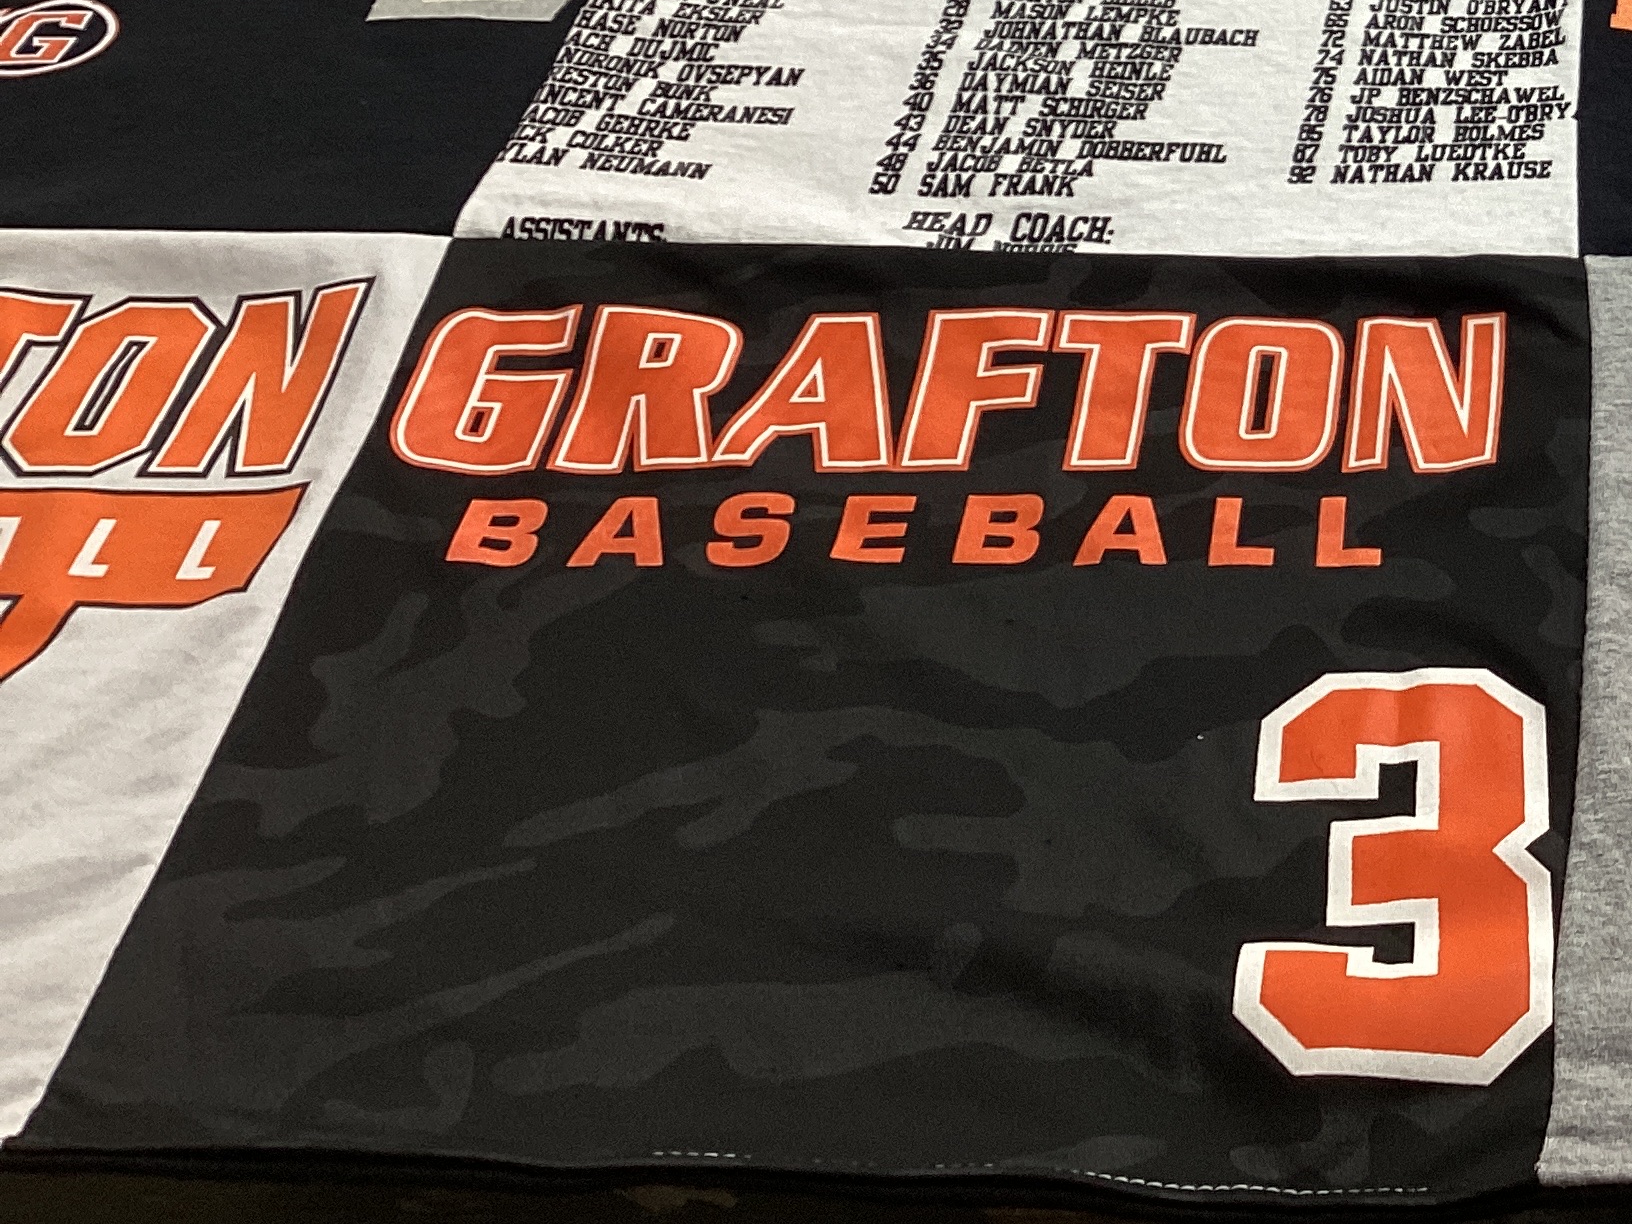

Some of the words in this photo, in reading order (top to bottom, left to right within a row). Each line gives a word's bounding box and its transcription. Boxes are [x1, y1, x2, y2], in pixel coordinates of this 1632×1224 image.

[1361, 30, 1482, 51] MATTHEW
[1498, 30, 1566, 51] ZABEL
[1312, 66, 1338, 86] 75
[1353, 67, 1425, 86] AIDAN
[1445, 69, 1509, 87] WEST
[637, 98, 795, 126] CAMERANESI
[902, 91, 934, 112] 40
[950, 92, 1026, 116] MATT
[1038, 97, 1149, 120] SCHIRGER
[869, 173, 900, 195] 50
[917, 173, 976, 197] SAM
[988, 173, 1079, 198] FRANK
[1330, 163, 1436, 184] NATHAN
[1451, 159, 1552, 182] KRAUSE
[902, 210, 994, 237] HEAD
[1010, 212, 1116, 244] COACH:
[389, 303, 1507, 475] GRAFTON
[446, 492, 1383, 570] BASEBALL
[1232, 668, 1554, 1086] 3
